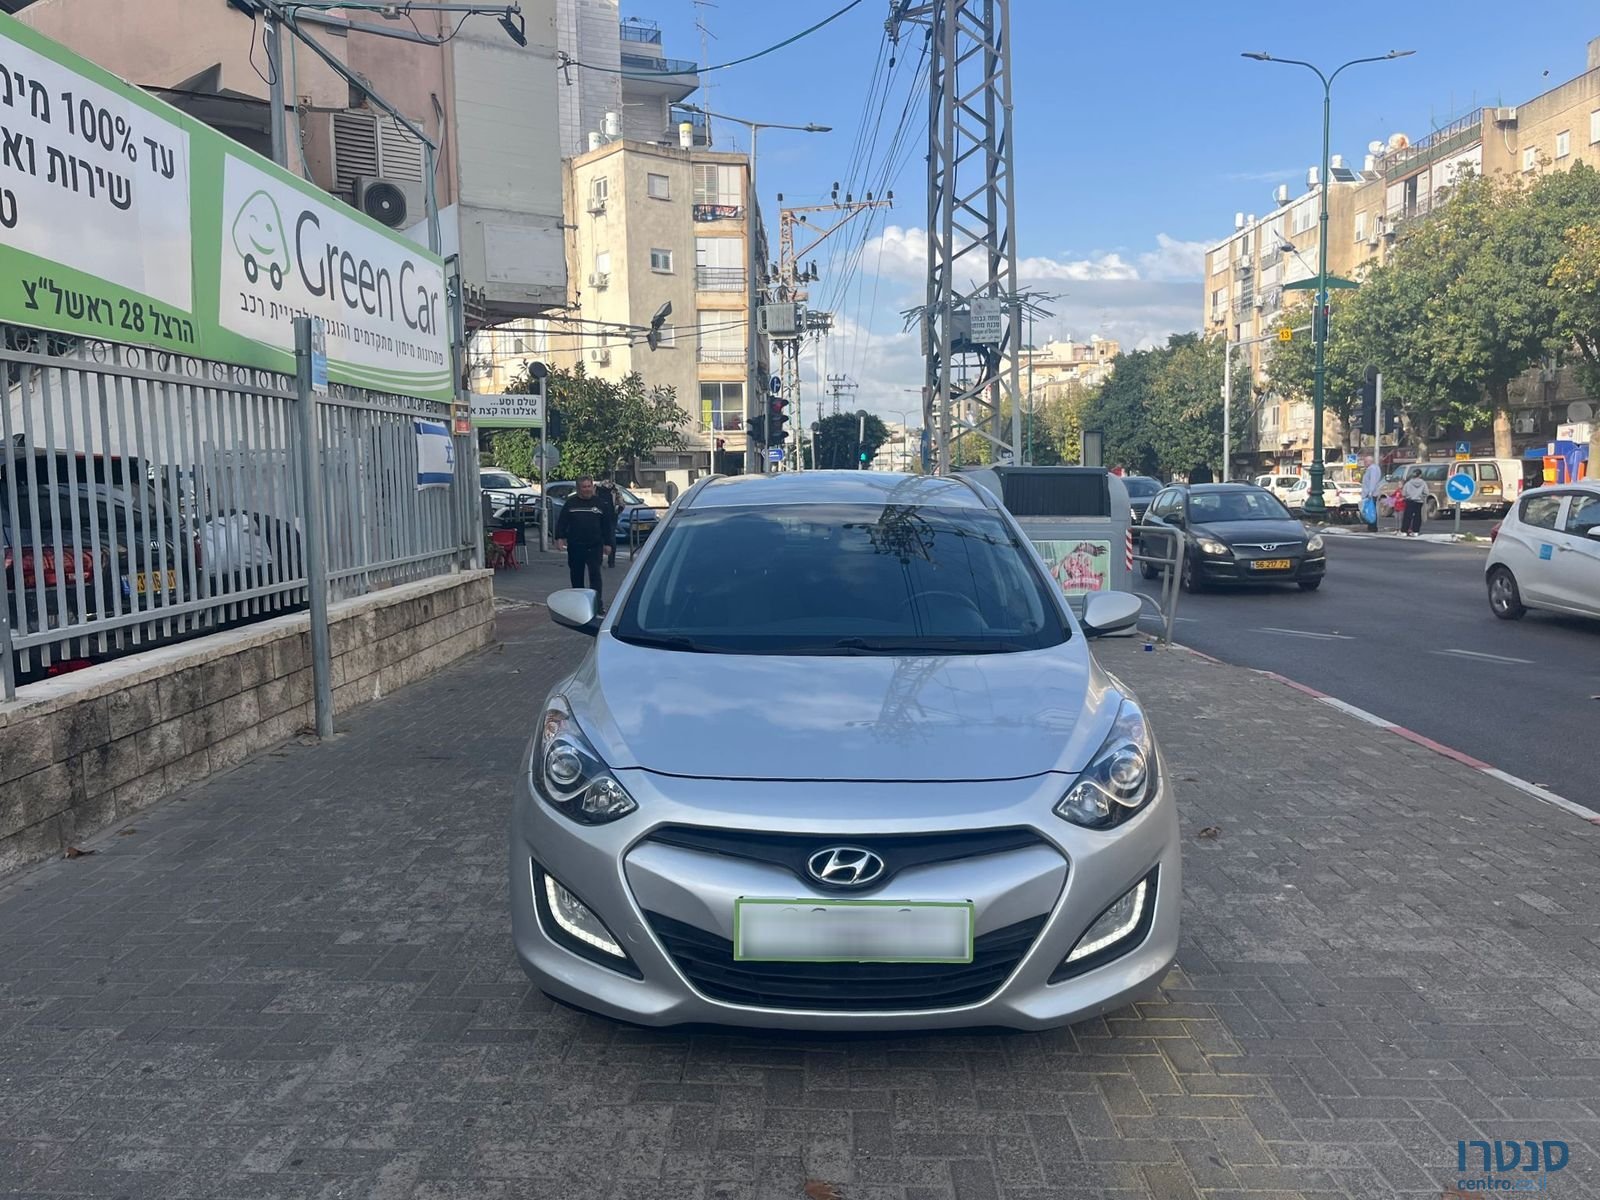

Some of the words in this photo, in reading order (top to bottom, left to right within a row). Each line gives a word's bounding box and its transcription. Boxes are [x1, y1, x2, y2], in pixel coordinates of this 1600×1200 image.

[61, 92, 138, 162] 100%
[143, 136, 175, 179] עד
[46, 145, 132, 211] שירות
[295, 210, 394, 322] Green
[399, 260, 438, 336] Car
[118, 298, 145, 333] 28
[239, 292, 265, 316] רכב
[149, 304, 195, 344] הרצל
[1280, 330, 1290, 339] 13
[353, 327, 393, 352] מתקדמים
[395, 339, 415, 358] מימון
[417, 346, 444, 366] פתרונות
[478, 407, 498, 416] קצת
[500, 407, 510, 415] זה
[513, 407, 537, 415] אצלנו
[517, 397, 537, 406] שלם
